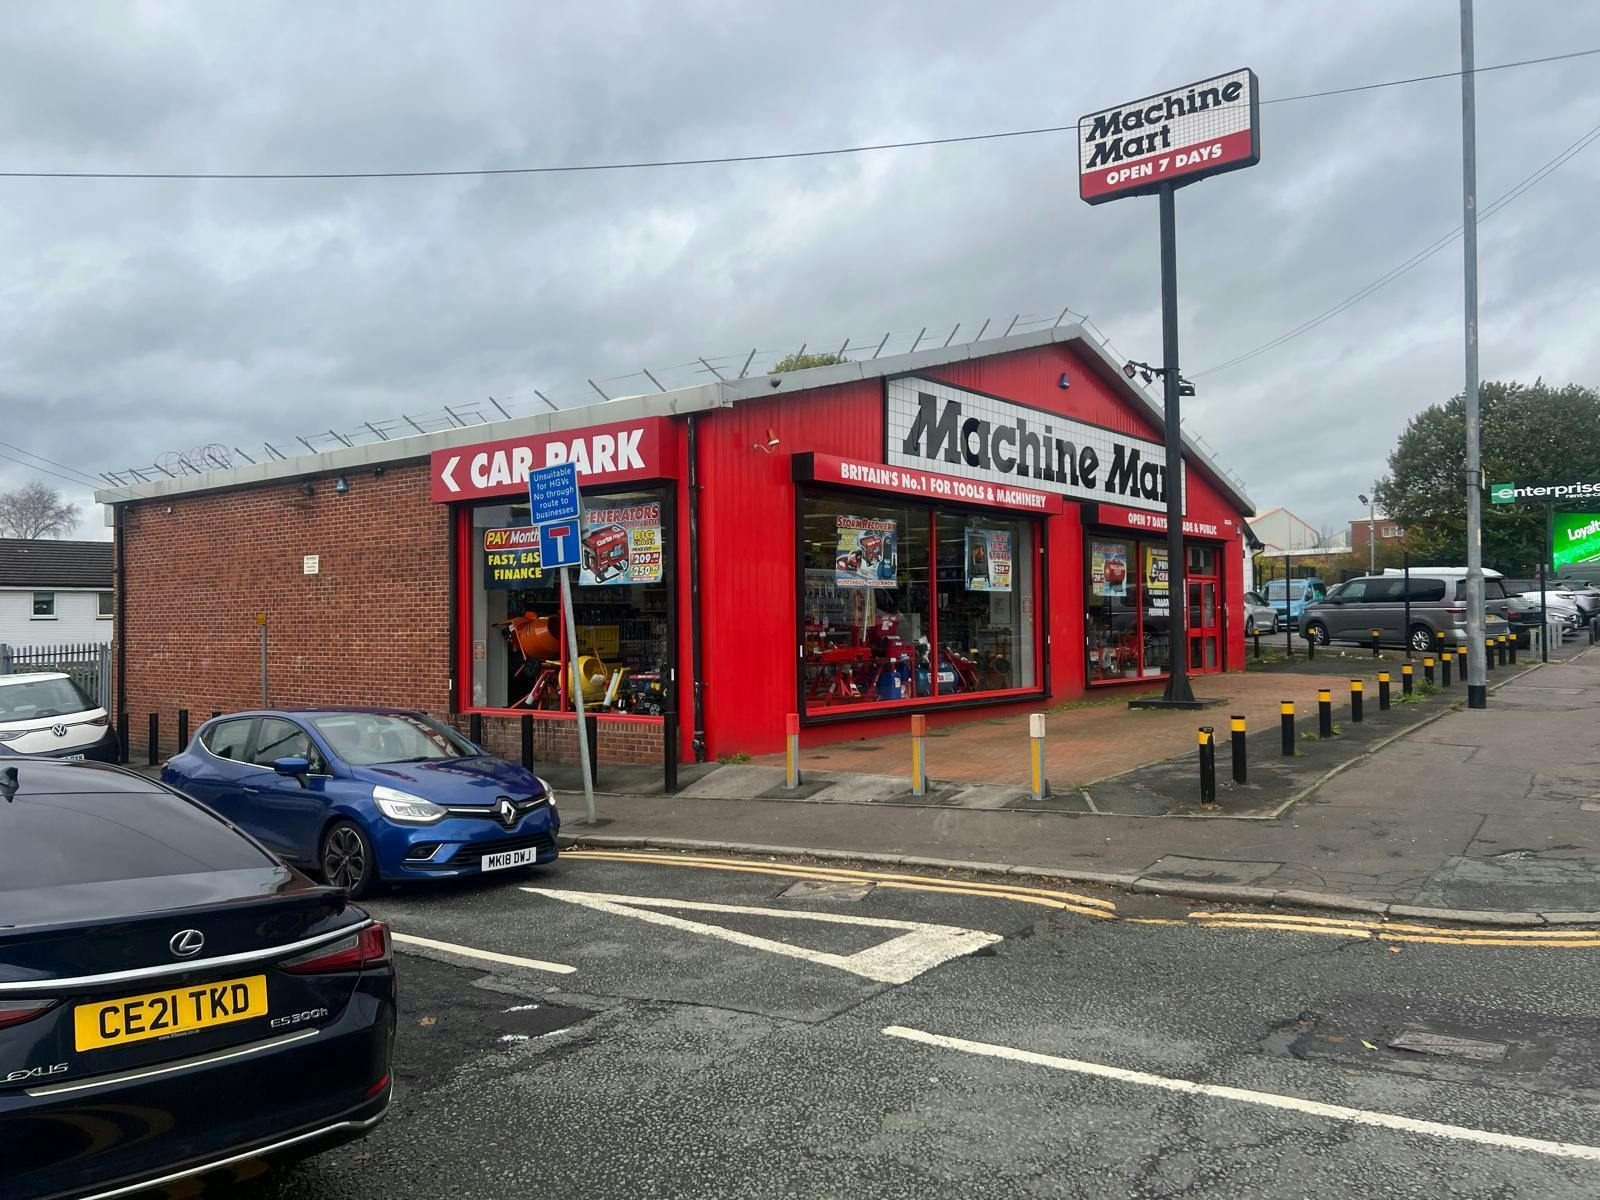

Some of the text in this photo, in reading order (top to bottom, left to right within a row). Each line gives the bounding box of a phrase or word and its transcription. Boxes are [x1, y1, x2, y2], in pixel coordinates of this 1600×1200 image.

[1085, 81, 1243, 143] Machine
[1086, 124, 1171, 169] Mart
[1106, 143, 1223, 185] OPEN 7 DAYS
[903, 391, 1168, 502] Machine Mar
[470, 428, 646, 490] CAR PARK
[533, 467, 571, 481] Unsuitable
[536, 478, 569, 490] for HGVs
[841, 463, 1046, 508] BRITAIN'S No.1 FOR TOOLS & MACHINERY
[1496, 482, 1600, 498] enterprise
[533, 486, 574, 501] No through
[536, 506, 574, 520] businesses
[540, 500, 559, 509] route
[586, 505, 659, 524] ENERATORS
[1128, 513, 1145, 526] OPEN
[1146, 514, 1151, 526] 7
[1152, 515, 1167, 528] DAYS
[1194, 522, 1199, 532] &
[1200, 523, 1217, 535] PUBLIC
[486, 529, 540, 545] PAY Month
[632, 530, 655, 540] BIG
[488, 552, 541, 567] FAST, EAS
[494, 567, 542, 580] FINANCE
[488, 850, 532, 868] MK18 DWJ
[99, 983, 249, 1040] CE21 TKD
